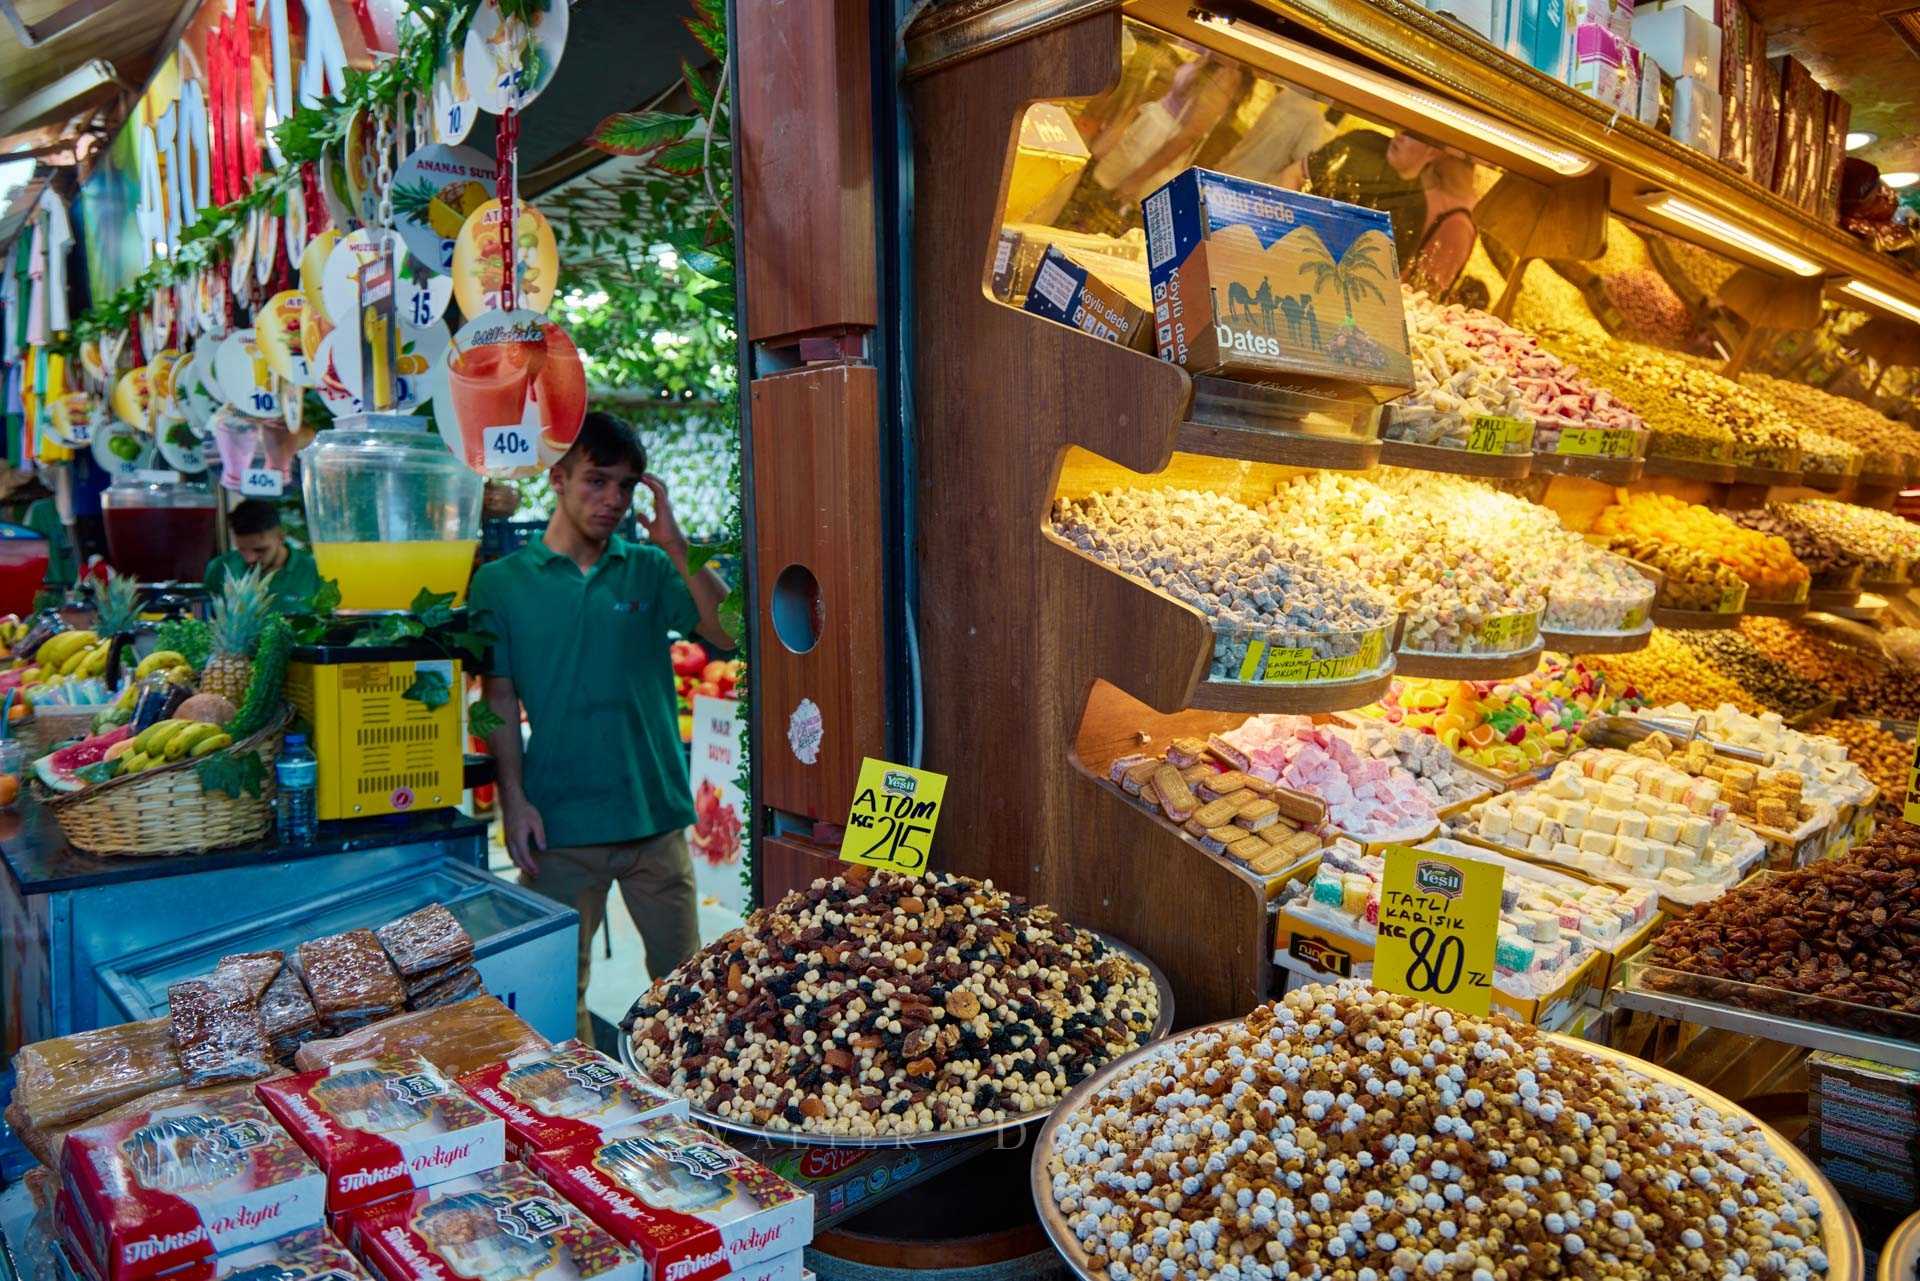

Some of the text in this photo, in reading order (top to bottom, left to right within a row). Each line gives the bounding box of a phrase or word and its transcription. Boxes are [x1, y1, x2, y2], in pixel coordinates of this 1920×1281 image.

[448, 105, 462, 134] 10
[416, 159, 465, 177] ANANAS
[1077, 285, 1105, 314] Köylü
[1104, 307, 1130, 333] dede
[1168, 266, 1188, 366] Köylü dede
[1215, 323, 1281, 357] Dates
[853, 788, 937, 820] ATOM
[850, 812, 932, 869] KG 215
[1421, 866, 1459, 889] Yeşil
[1385, 907, 1465, 930] KARIŞIK
[1387, 890, 1451, 914] TATLI
[1405, 926, 1465, 995] 80
[1467, 970, 1493, 988] TL
[338, 1142, 473, 1194] Turkish Delight
[210, 1201, 284, 1236] Delight
[729, 1222, 785, 1256] Delight
